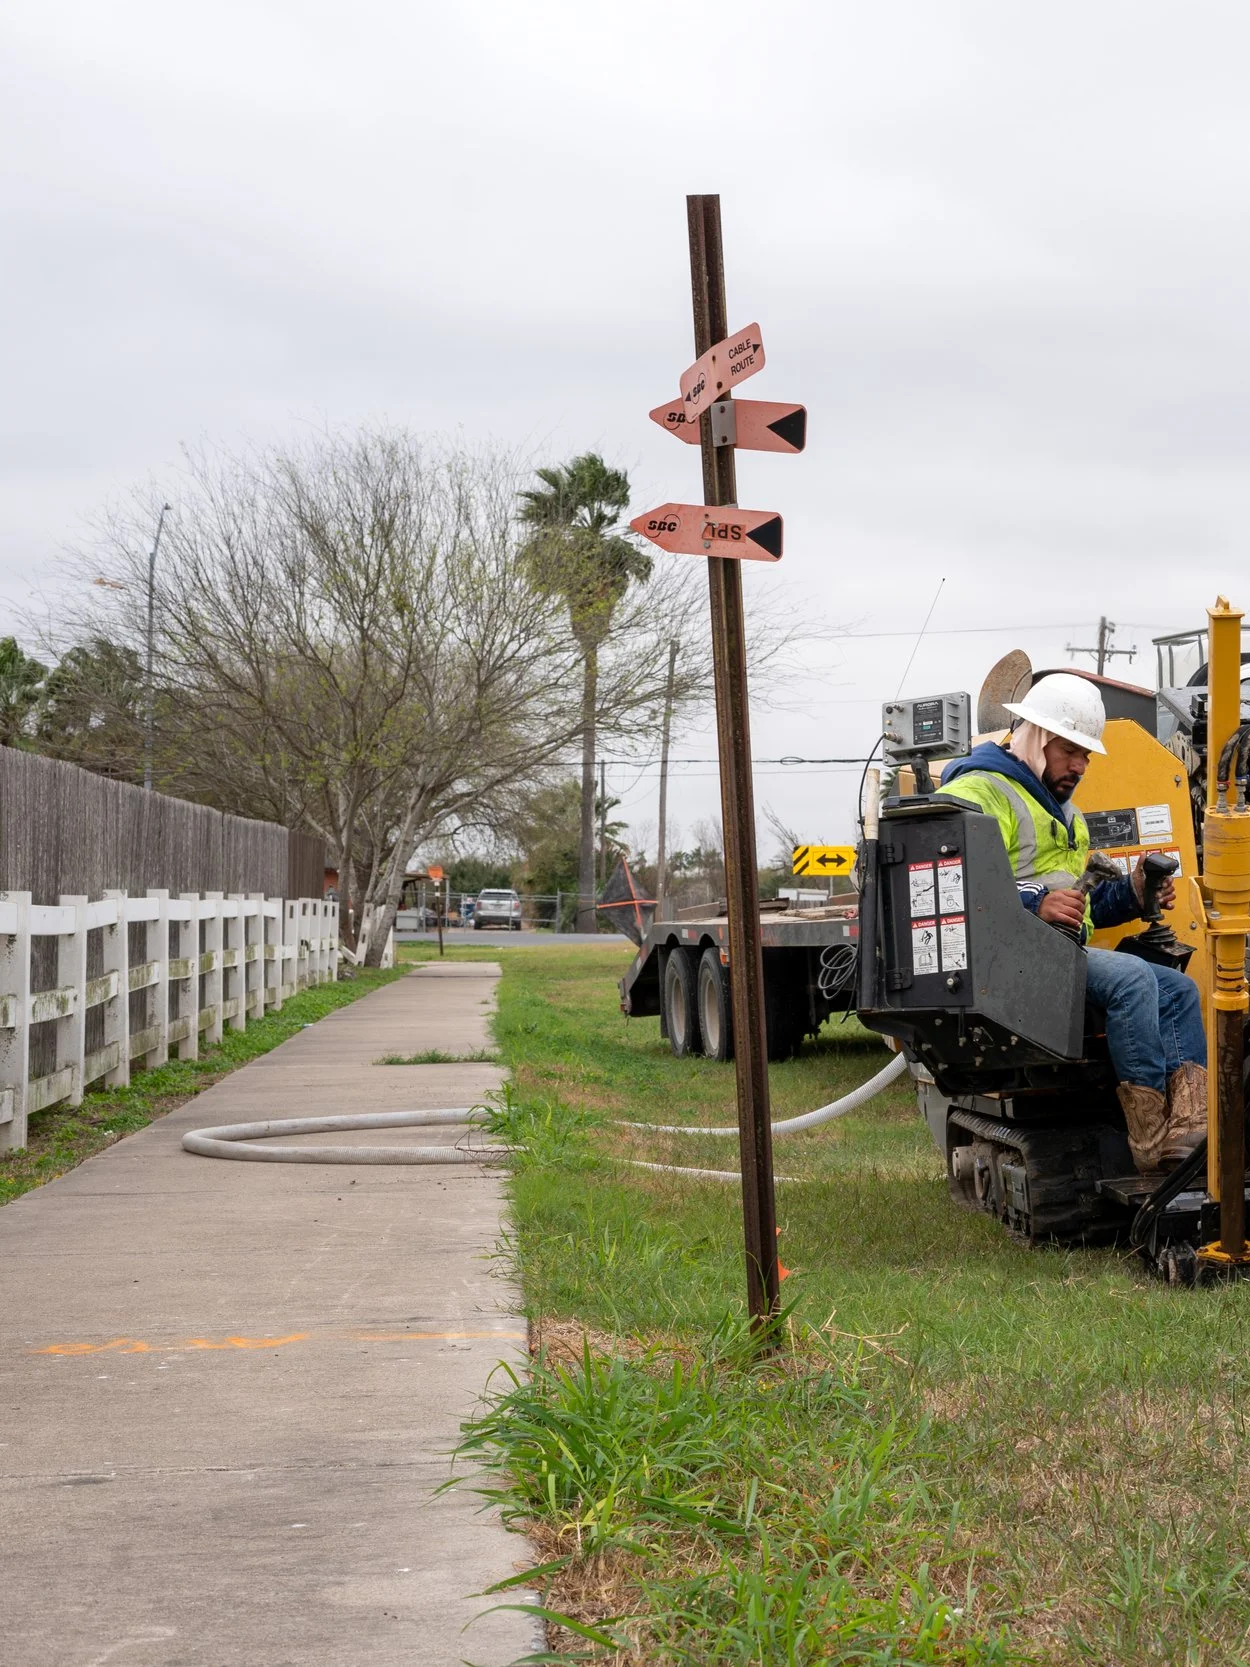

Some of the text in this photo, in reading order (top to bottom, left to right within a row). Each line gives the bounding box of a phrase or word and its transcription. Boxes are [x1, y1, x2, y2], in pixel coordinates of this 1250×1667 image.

[728, 338, 752, 359] CABLE
[730, 354, 755, 376] ROUTE
[692, 379, 705, 397] SBC
[648, 520, 678, 532] SBC
